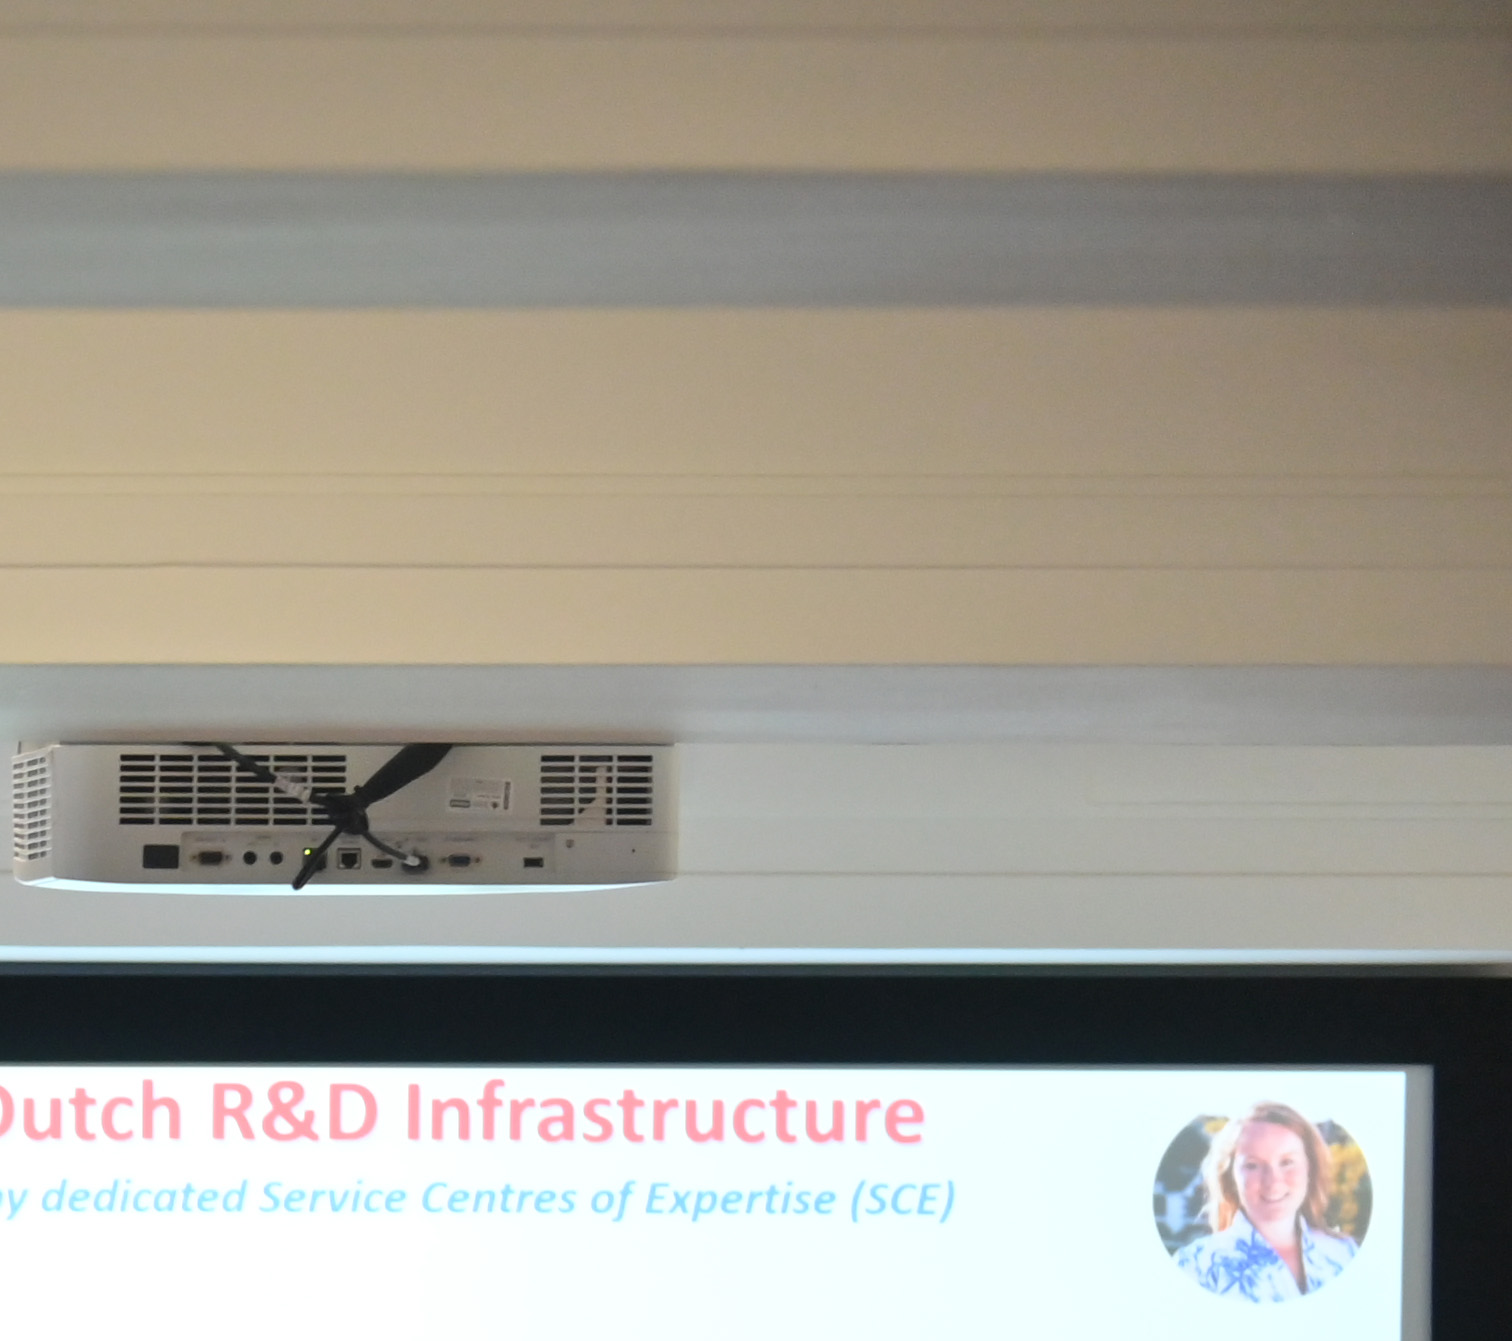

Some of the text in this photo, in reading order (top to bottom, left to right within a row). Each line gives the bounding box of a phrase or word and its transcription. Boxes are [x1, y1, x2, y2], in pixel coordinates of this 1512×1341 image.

[212, 1080, 378, 1142] R&D
[408, 1079, 926, 1144] Infrastructure
[41, 1178, 247, 1213] dedicated
[261, 1180, 407, 1213] Service
[421, 1181, 577, 1214] Centres
[590, 1180, 637, 1221] of
[645, 1181, 837, 1222] Expertise
[851, 1180, 956, 1223] (SCE)
